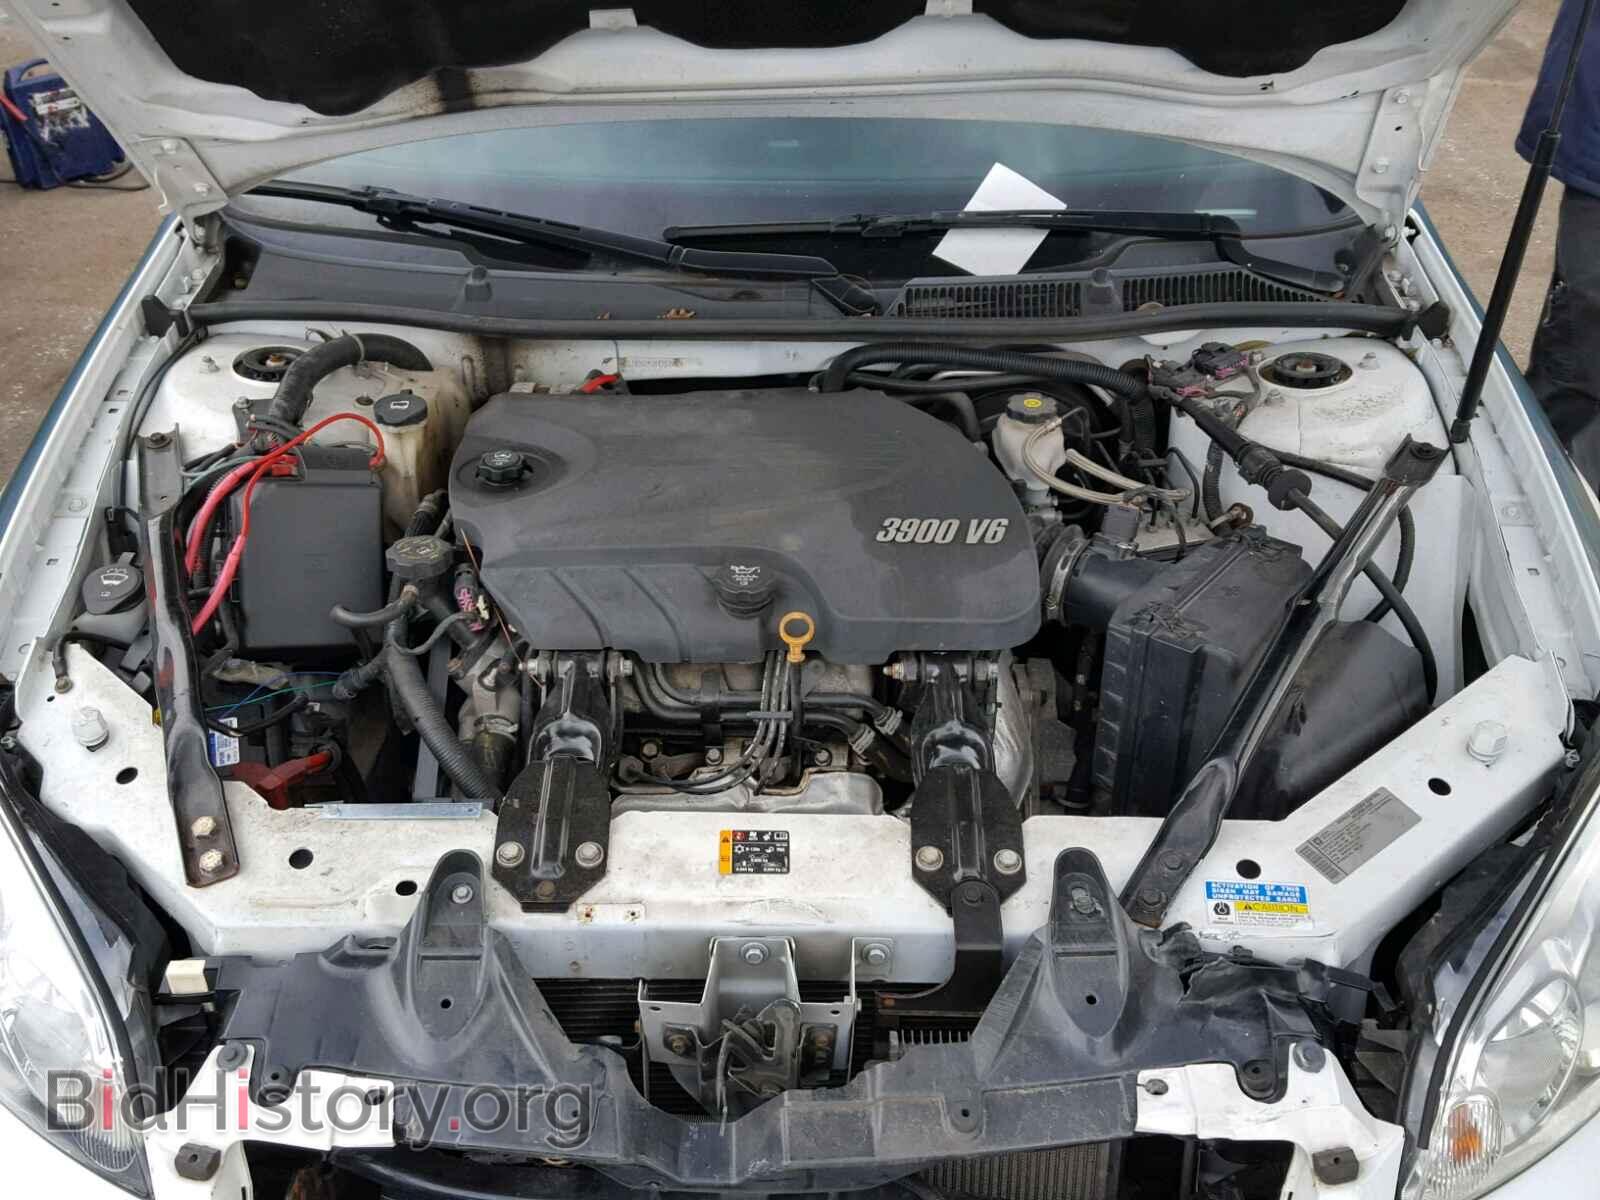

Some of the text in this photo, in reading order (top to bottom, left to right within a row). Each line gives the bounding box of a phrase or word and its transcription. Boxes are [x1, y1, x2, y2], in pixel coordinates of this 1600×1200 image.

[876, 517, 1009, 544] 3900 V6
[1211, 881, 1259, 890] ACTIVATION
[1252, 902, 1298, 912] CAUTION
